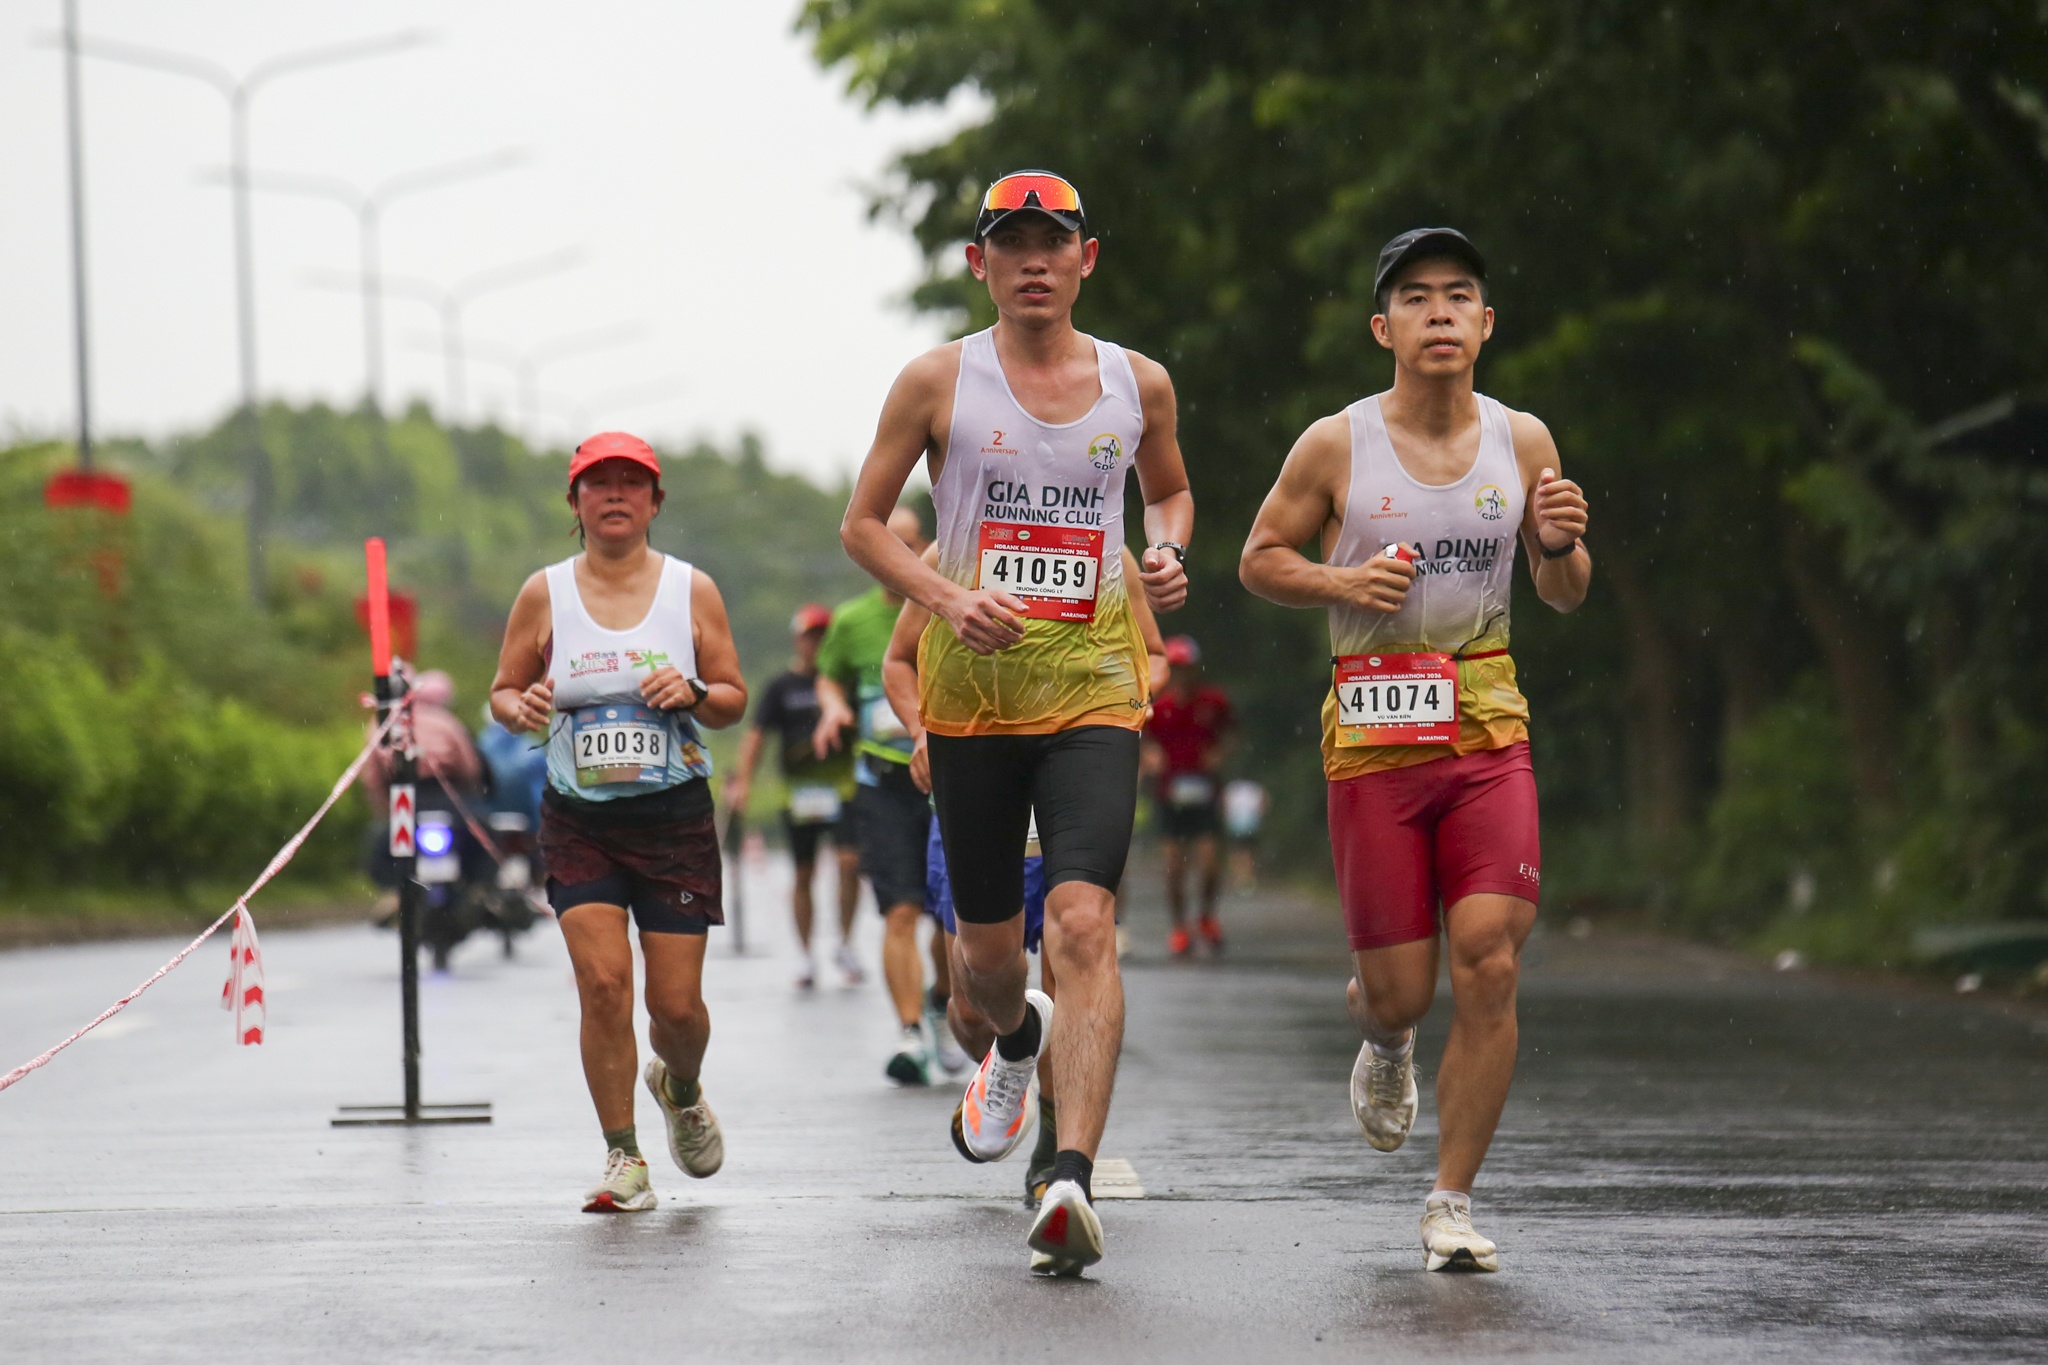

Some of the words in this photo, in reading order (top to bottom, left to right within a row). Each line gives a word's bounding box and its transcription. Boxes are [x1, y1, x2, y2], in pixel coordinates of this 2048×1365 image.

[980, 447, 1019, 456] Anniversary
[1094, 461, 1116, 472] GDC
[987, 480, 1031, 505] GIA
[984, 504, 1060, 524] RUNNING
[1369, 511, 1408, 520] Anniversary
[1481, 512, 1503, 521] GDC
[994, 543, 1019, 551] HDBANK
[1040, 546, 1075, 555] MARATHON
[1435, 538, 1499, 559] DINH
[993, 555, 1086, 588] 41059
[1456, 559, 1493, 573] CLUB
[582, 651, 618, 661] HDBank
[1351, 684, 1440, 713] 41074
[583, 731, 660, 757] 20038
